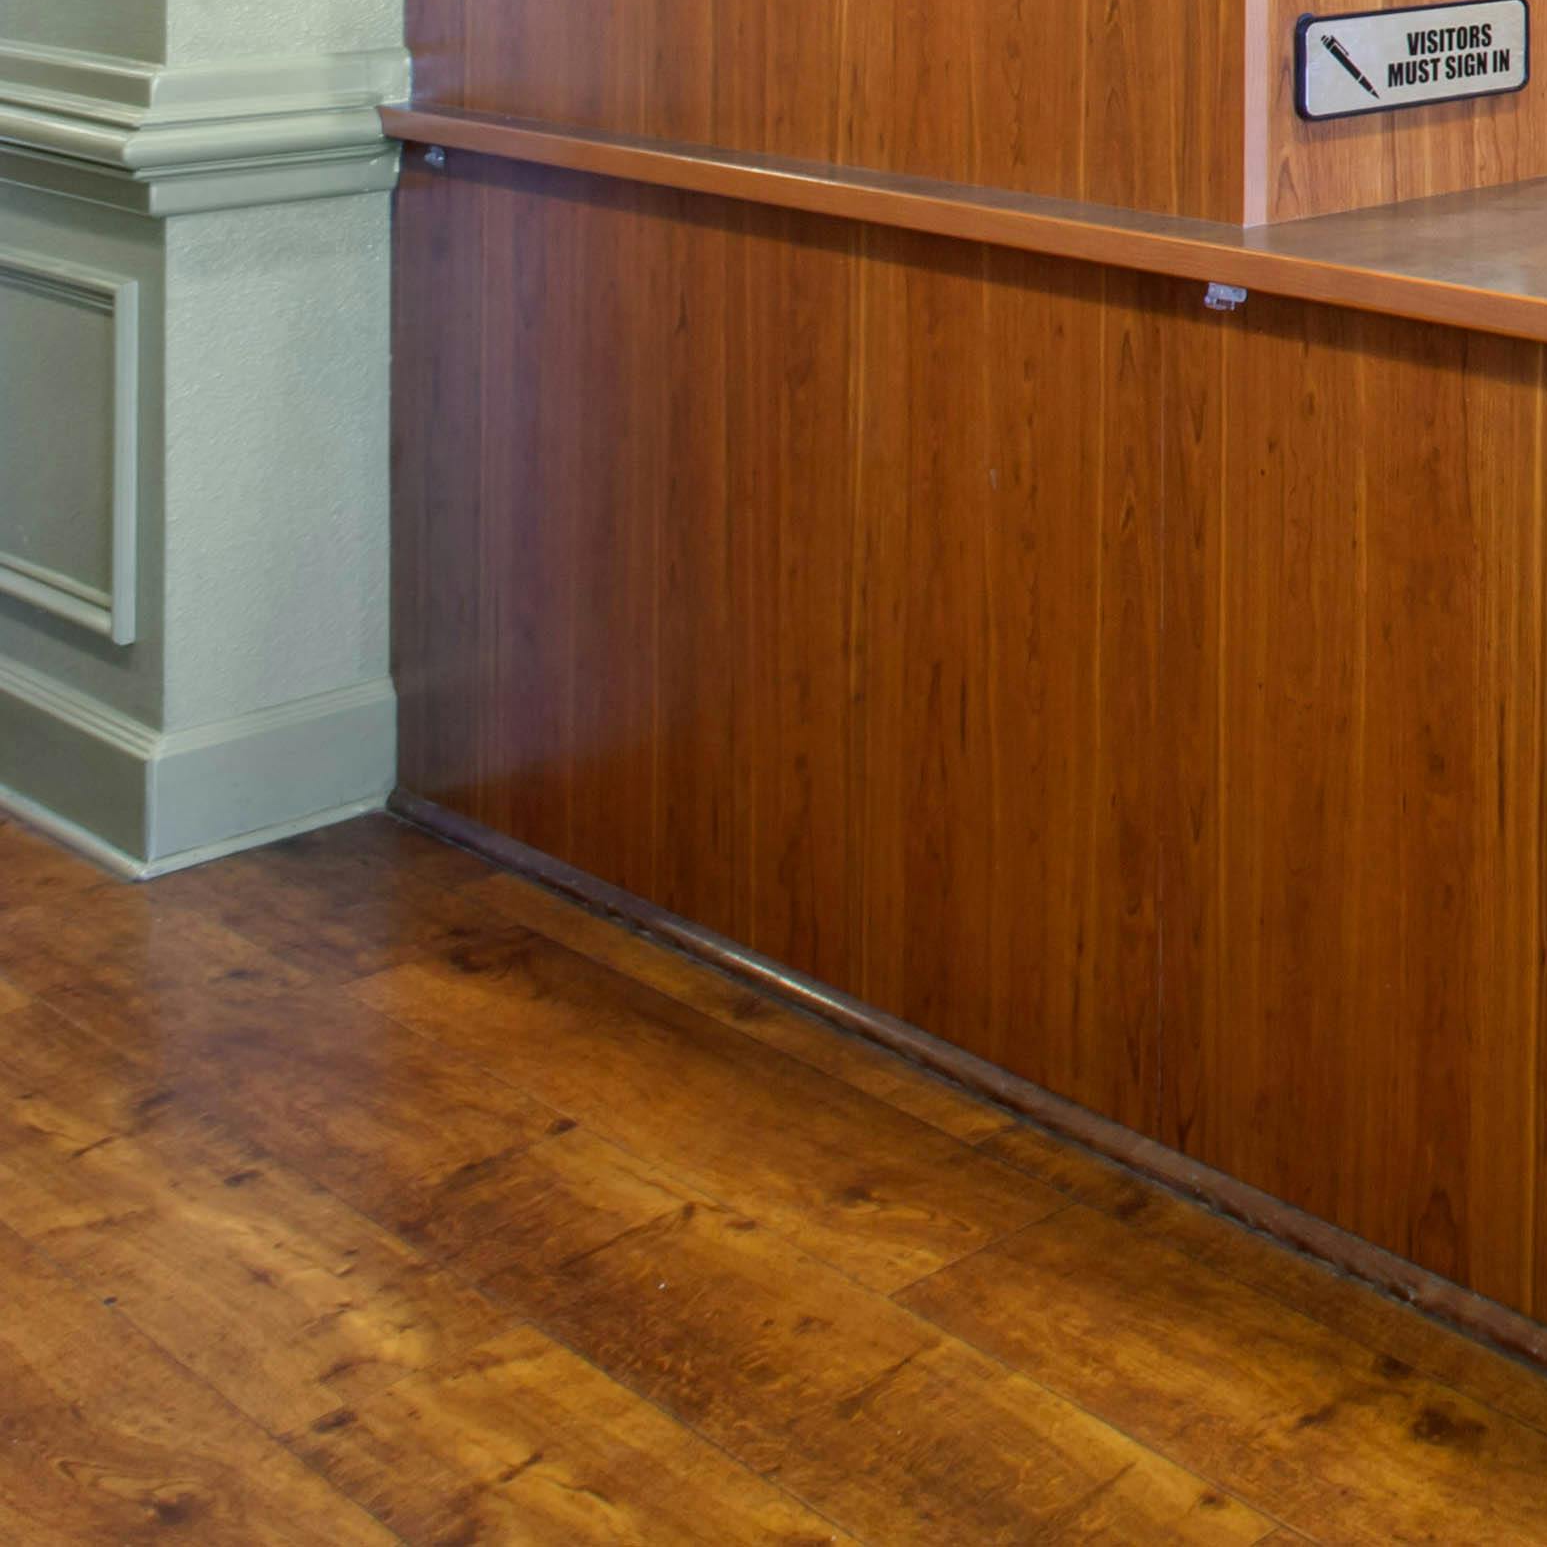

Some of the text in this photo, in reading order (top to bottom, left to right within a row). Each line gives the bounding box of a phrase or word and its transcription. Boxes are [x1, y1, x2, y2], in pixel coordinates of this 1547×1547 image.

[1406, 23, 1493, 56] VISITORS
[1387, 48, 1511, 88] MUST SIGN IN
